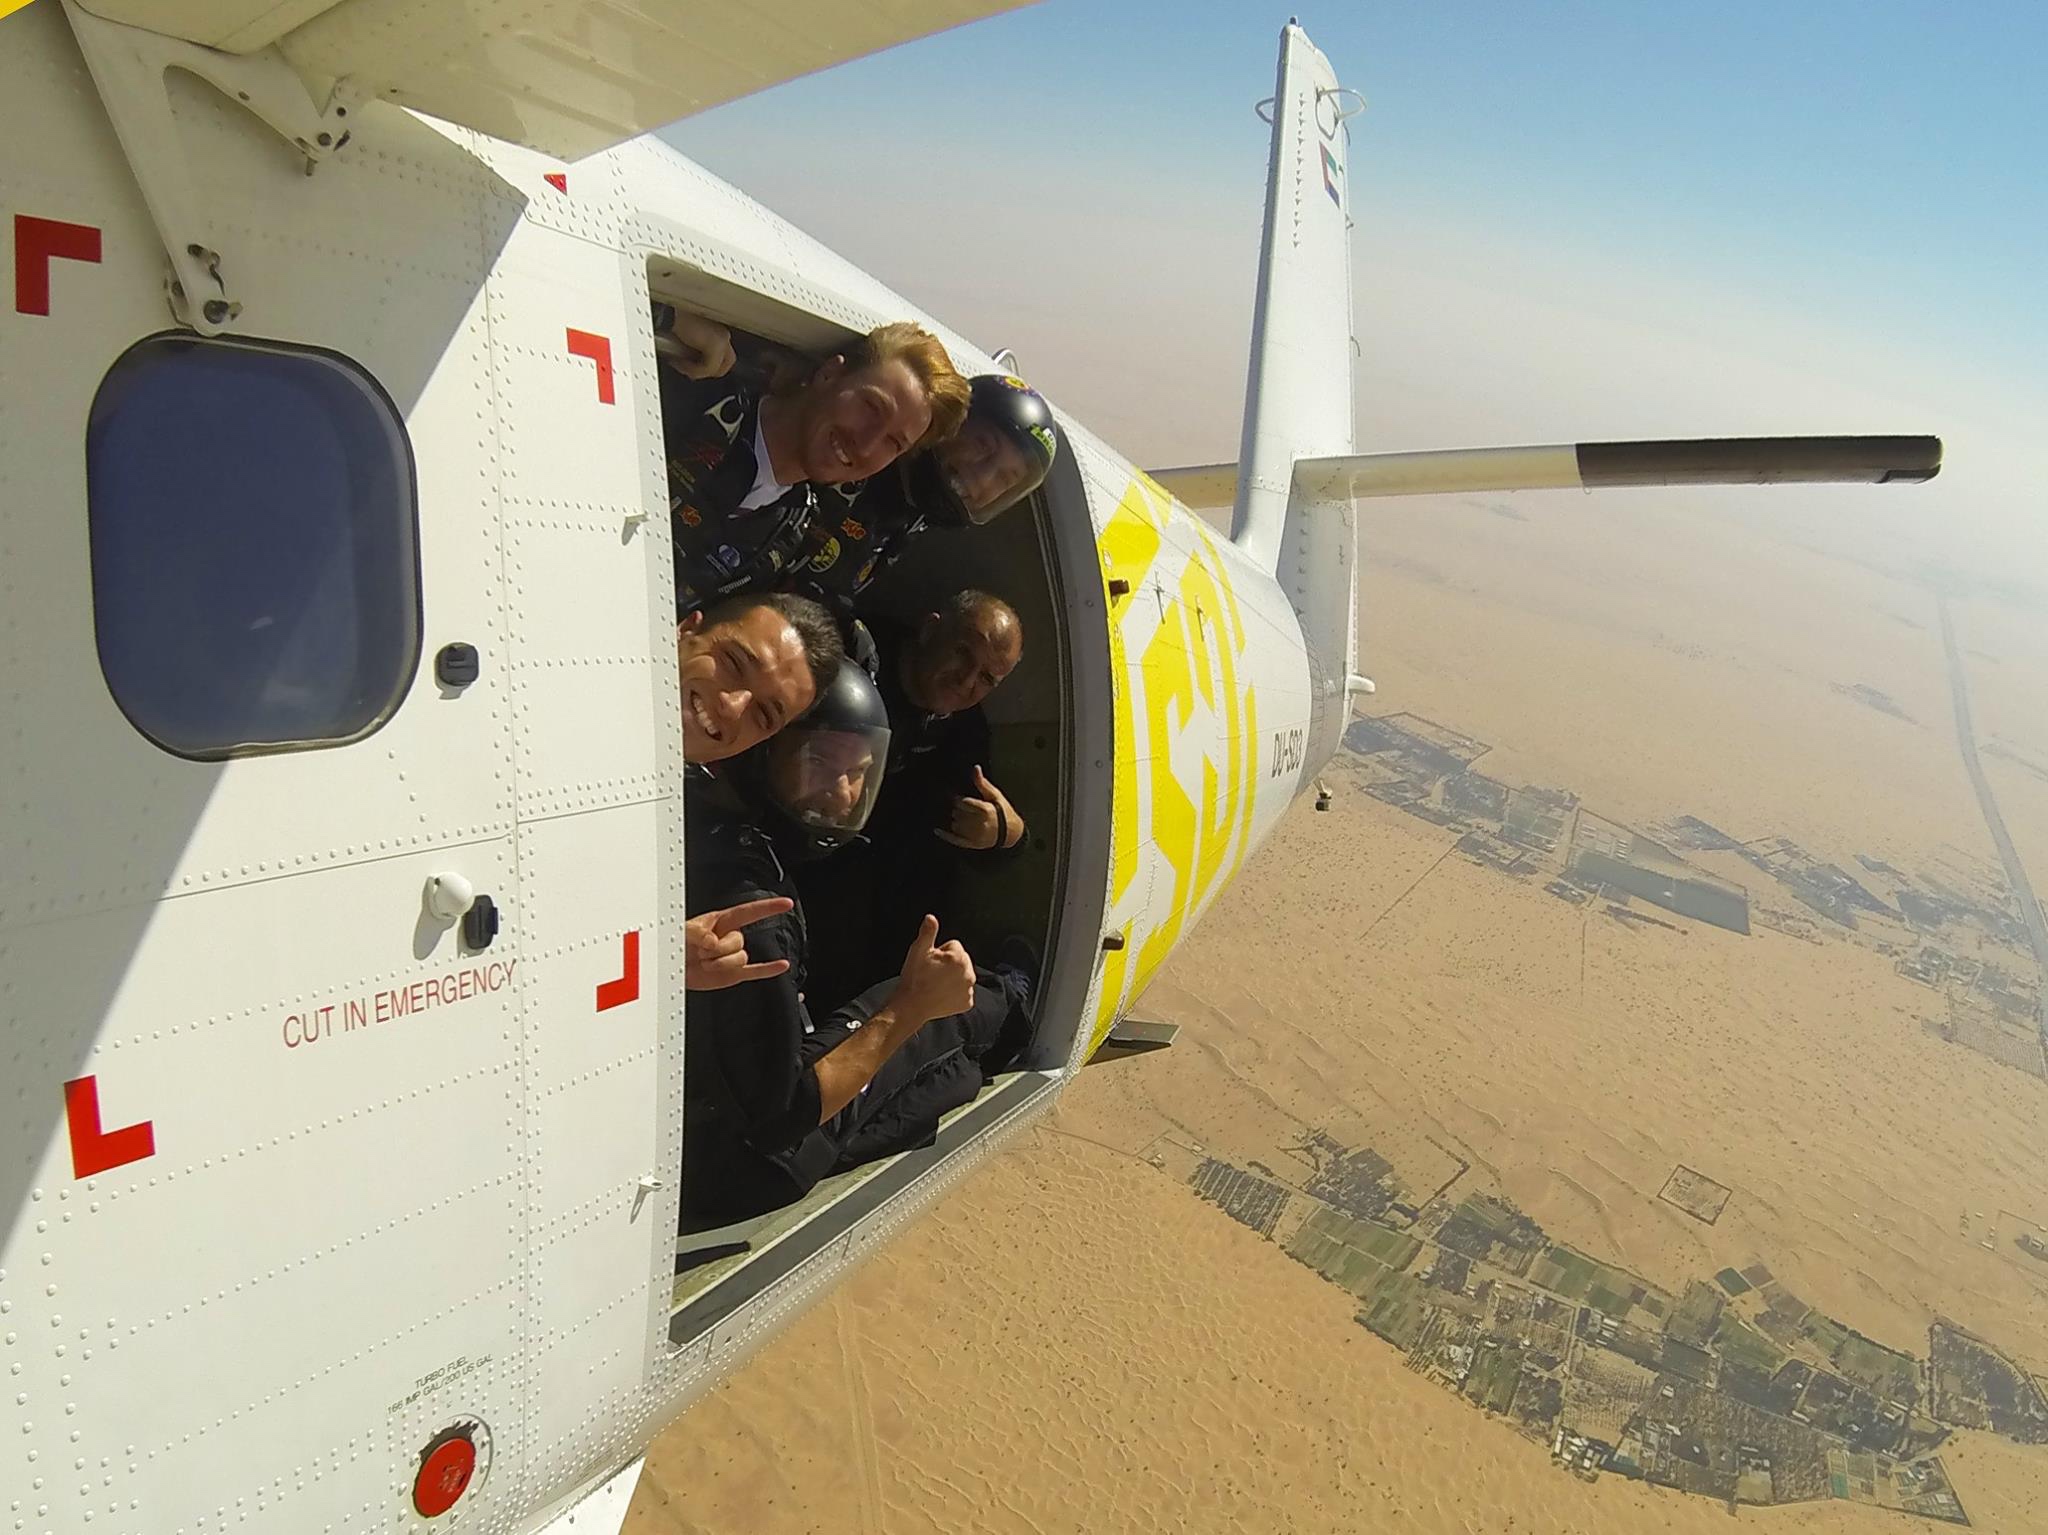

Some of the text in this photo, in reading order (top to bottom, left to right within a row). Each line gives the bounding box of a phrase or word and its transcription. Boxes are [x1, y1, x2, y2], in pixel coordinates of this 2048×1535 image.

[283, 958, 517, 1048] CUT IN EMERGENCY
[415, 1356, 468, 1388] TURBO FUEL
